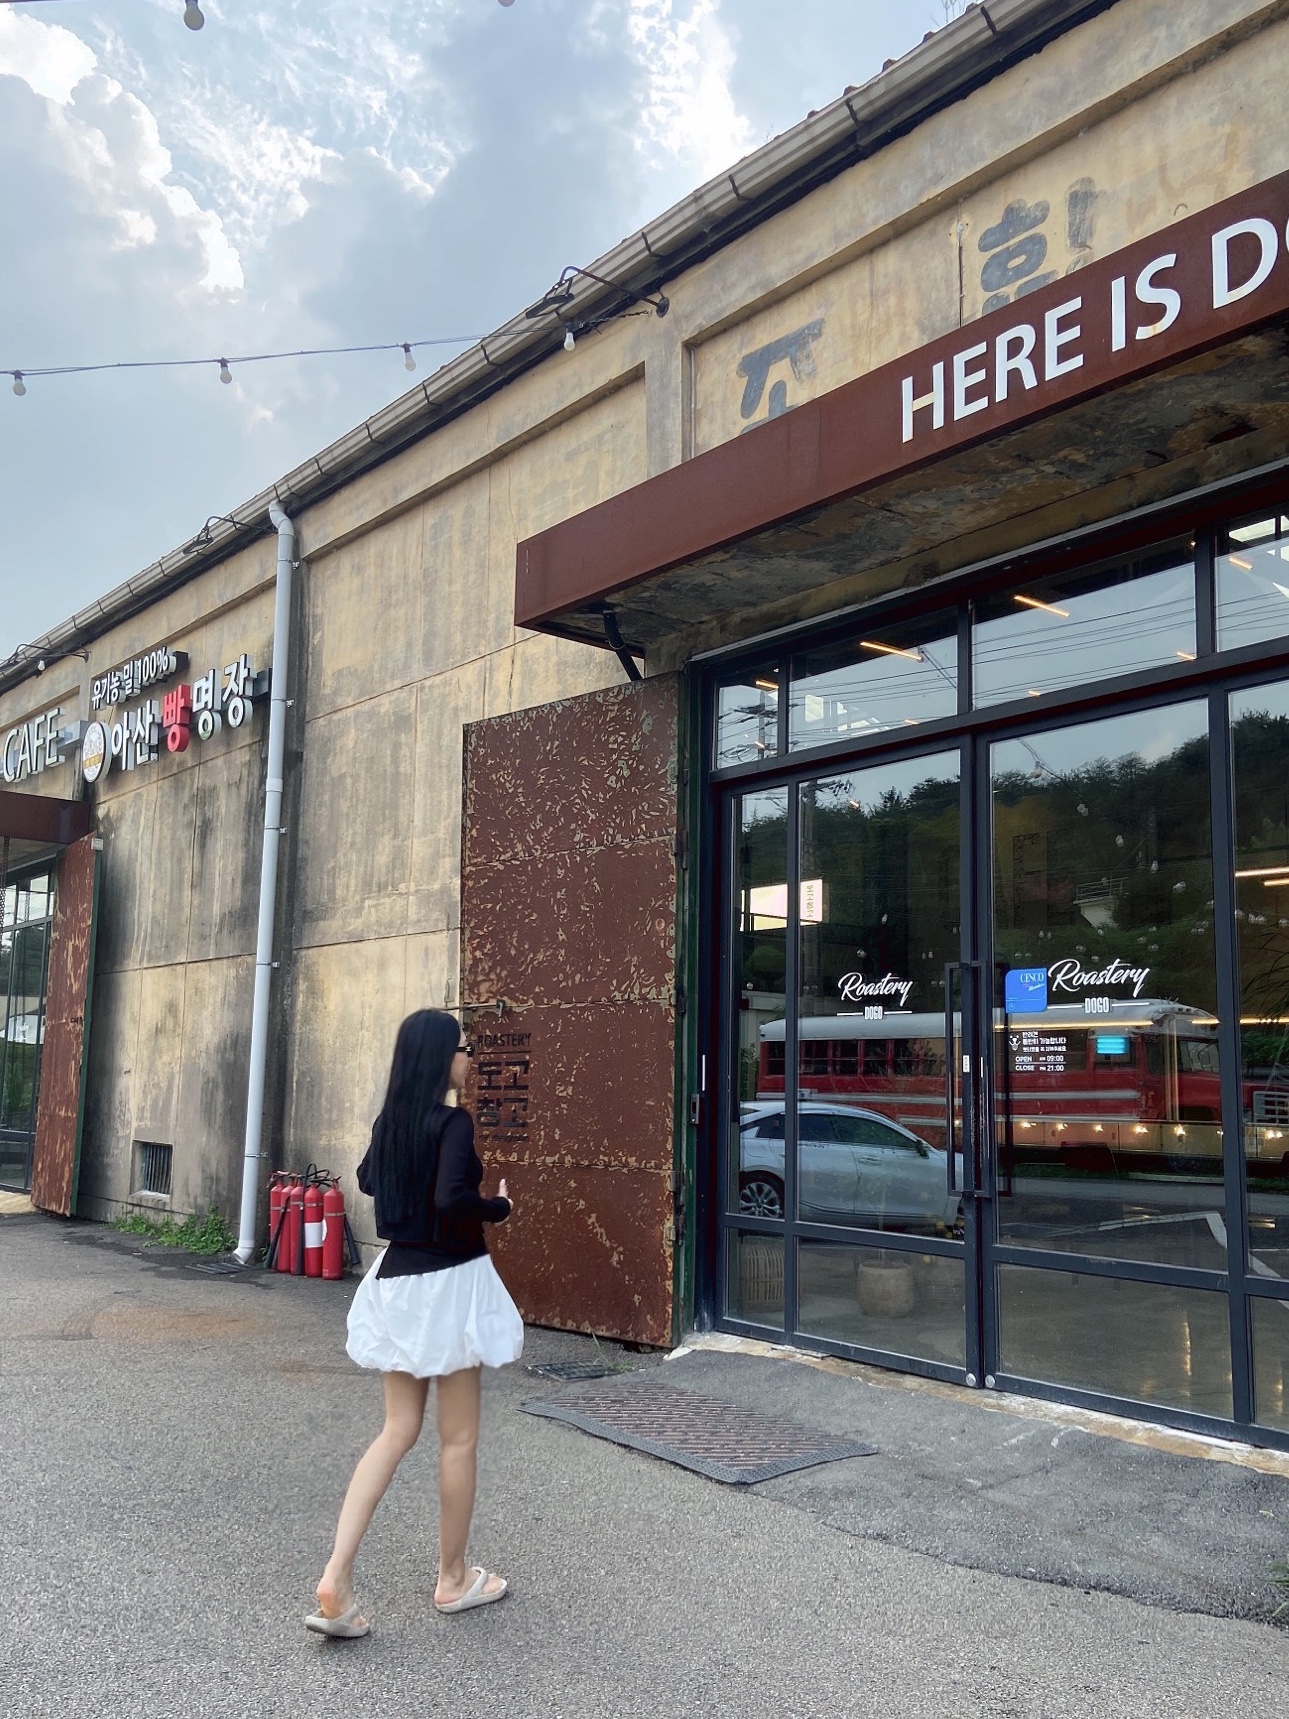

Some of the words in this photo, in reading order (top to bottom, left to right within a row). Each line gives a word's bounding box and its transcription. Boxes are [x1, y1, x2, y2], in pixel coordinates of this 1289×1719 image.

[902, 297, 1084, 443] HERE
[1111, 253, 1182, 352] IS
[1211, 216, 1289, 310] D
[92, 671, 121, 711] 유기농
[123, 660, 134, 696] 밀
[138, 646, 170, 685] 100%
[3, 708, 63, 783] CAFE
[837, 971, 913, 1006] Roastery
[1020, 972, 1045, 983] CESCO
[1048, 958, 1150, 998] Roastery
[864, 1005, 884, 1020] DOGO
[1084, 997, 1110, 1014] DOGO
[477, 1033, 532, 1048] ROASTERY
[1015, 1055, 1033, 1063] OPEN
[1046, 1064, 1065, 1072] 21:00
[477, 1060, 530, 1091] 도고
[476, 1097, 529, 1128] 창고
